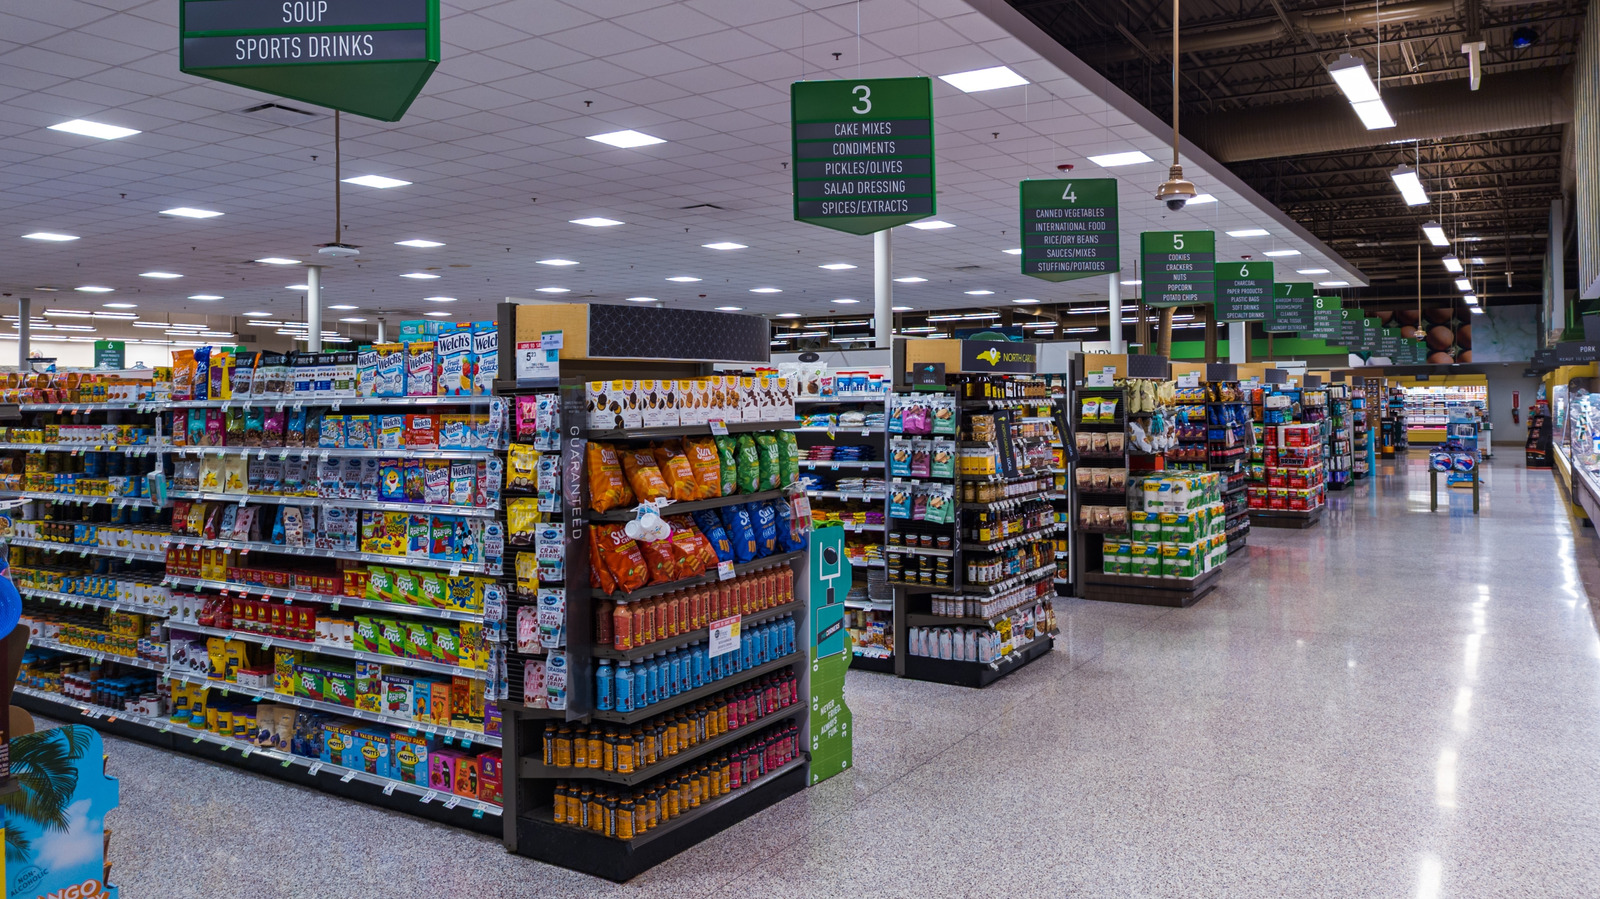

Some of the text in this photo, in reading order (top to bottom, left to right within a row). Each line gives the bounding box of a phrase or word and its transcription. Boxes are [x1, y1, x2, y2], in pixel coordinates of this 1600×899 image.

[282, 0, 328, 23] SOUP
[235, 34, 374, 60] SPORTS DRINKS
[852, 85, 872, 114] 3
[834, 122, 892, 136] CAKE MIXES
[832, 142, 896, 155] CONDIMENTS
[825, 161, 903, 175] PICKLES/OLIVES
[824, 180, 906, 195] SALAD DRESSING
[1062, 183, 1077, 203] 4
[822, 200, 908, 214] SPICES/EXTRACTS
[1036, 208, 1105, 218] CANNED VEGETABLES
[1035, 222, 1106, 232] INTERNATIONAL FOOD
[1044, 235, 1099, 244] RICE/DRY BEANS
[1173, 234, 1184, 250] 5
[1047, 248, 1096, 258] SAUCES/MIXES
[1038, 262, 1105, 271] STUFFING/POTATOES
[1240, 264, 1249, 277] 6
[1285, 285, 1292, 295] 7
[1316, 299, 1323, 308] 8
[1342, 310, 1348, 319] 9
[439, 336, 470, 352] Welch's
[358, 354, 376, 366] Welch
[378, 354, 401, 369] Welch's
[409, 353, 432, 369] Welch's
[1003, 353, 1022, 362] NORTH
[382, 417, 400, 428] Welch's
[414, 419, 430, 427] Welch's
[446, 423, 463, 434] Welch's
[601, 449, 616, 462] Sun
[635, 454, 653, 465] Sun
[696, 447, 711, 460] Sun
[427, 469, 447, 483] Welch's
[570, 426, 582, 539] GUARANTEED
[759, 507, 774, 524] Sun
[611, 530, 626, 545] Su
[821, 699, 834, 716] NEVER
[821, 716, 837, 736] ALWAYS
[396, 734, 412, 742] FAMILY
[813, 734, 819, 750] 30
[399, 753, 417, 763] MOTT'S
[10, 868, 49, 897] ALCOHOLIC
[17, 870, 36, 884] NON-
